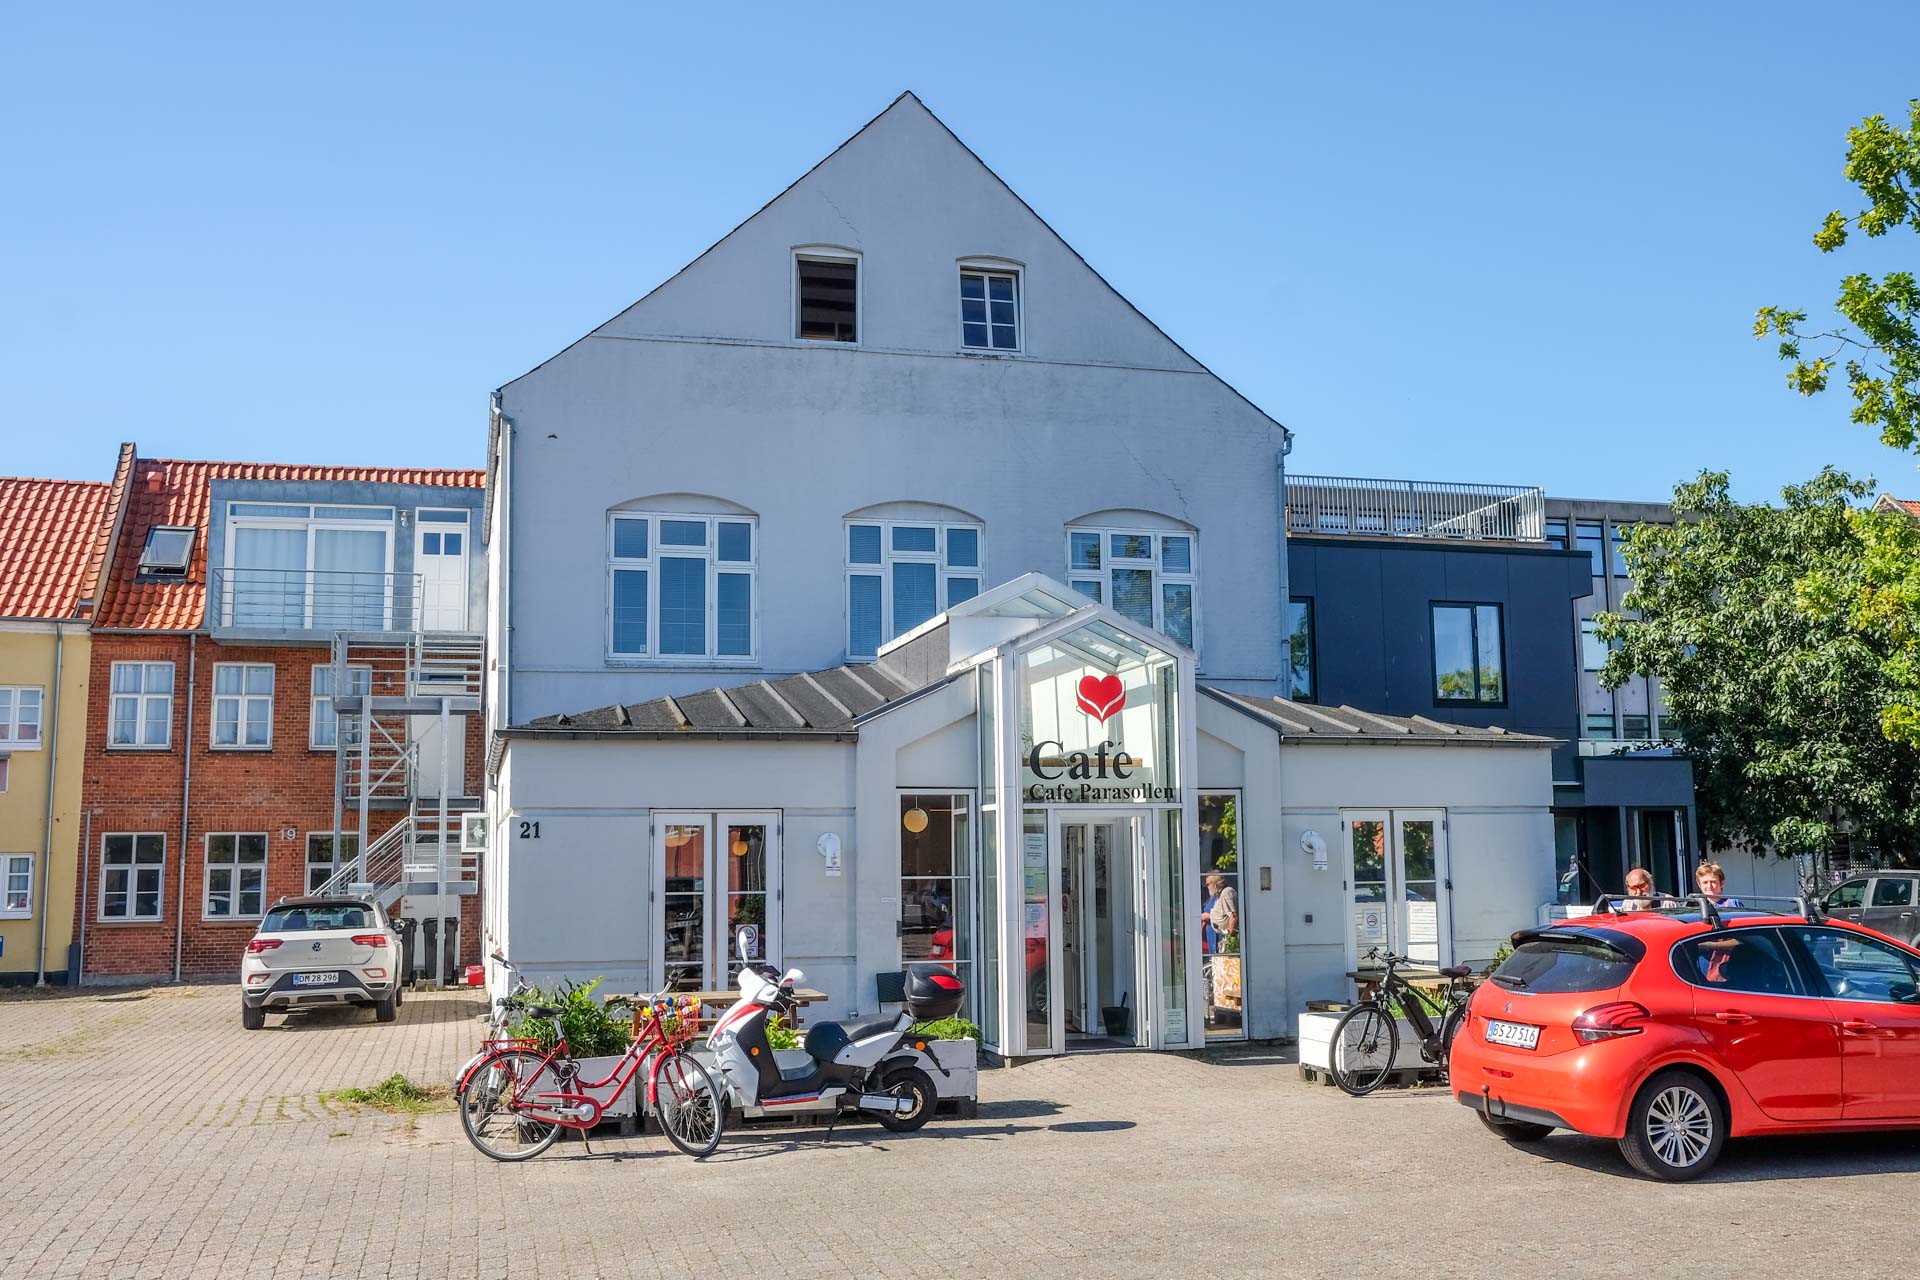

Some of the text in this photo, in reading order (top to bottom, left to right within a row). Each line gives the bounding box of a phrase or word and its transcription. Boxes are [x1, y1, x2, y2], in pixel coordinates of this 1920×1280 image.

[1029, 740, 1133, 780] Café
[1030, 783, 1174, 800] Cafe Parasollen
[279, 827, 296, 840] 19
[520, 821, 541, 839] 21
[312, 974, 321, 982] 28
[323, 973, 337, 981] 296
[1493, 1023, 1536, 1043] BS 27 516
